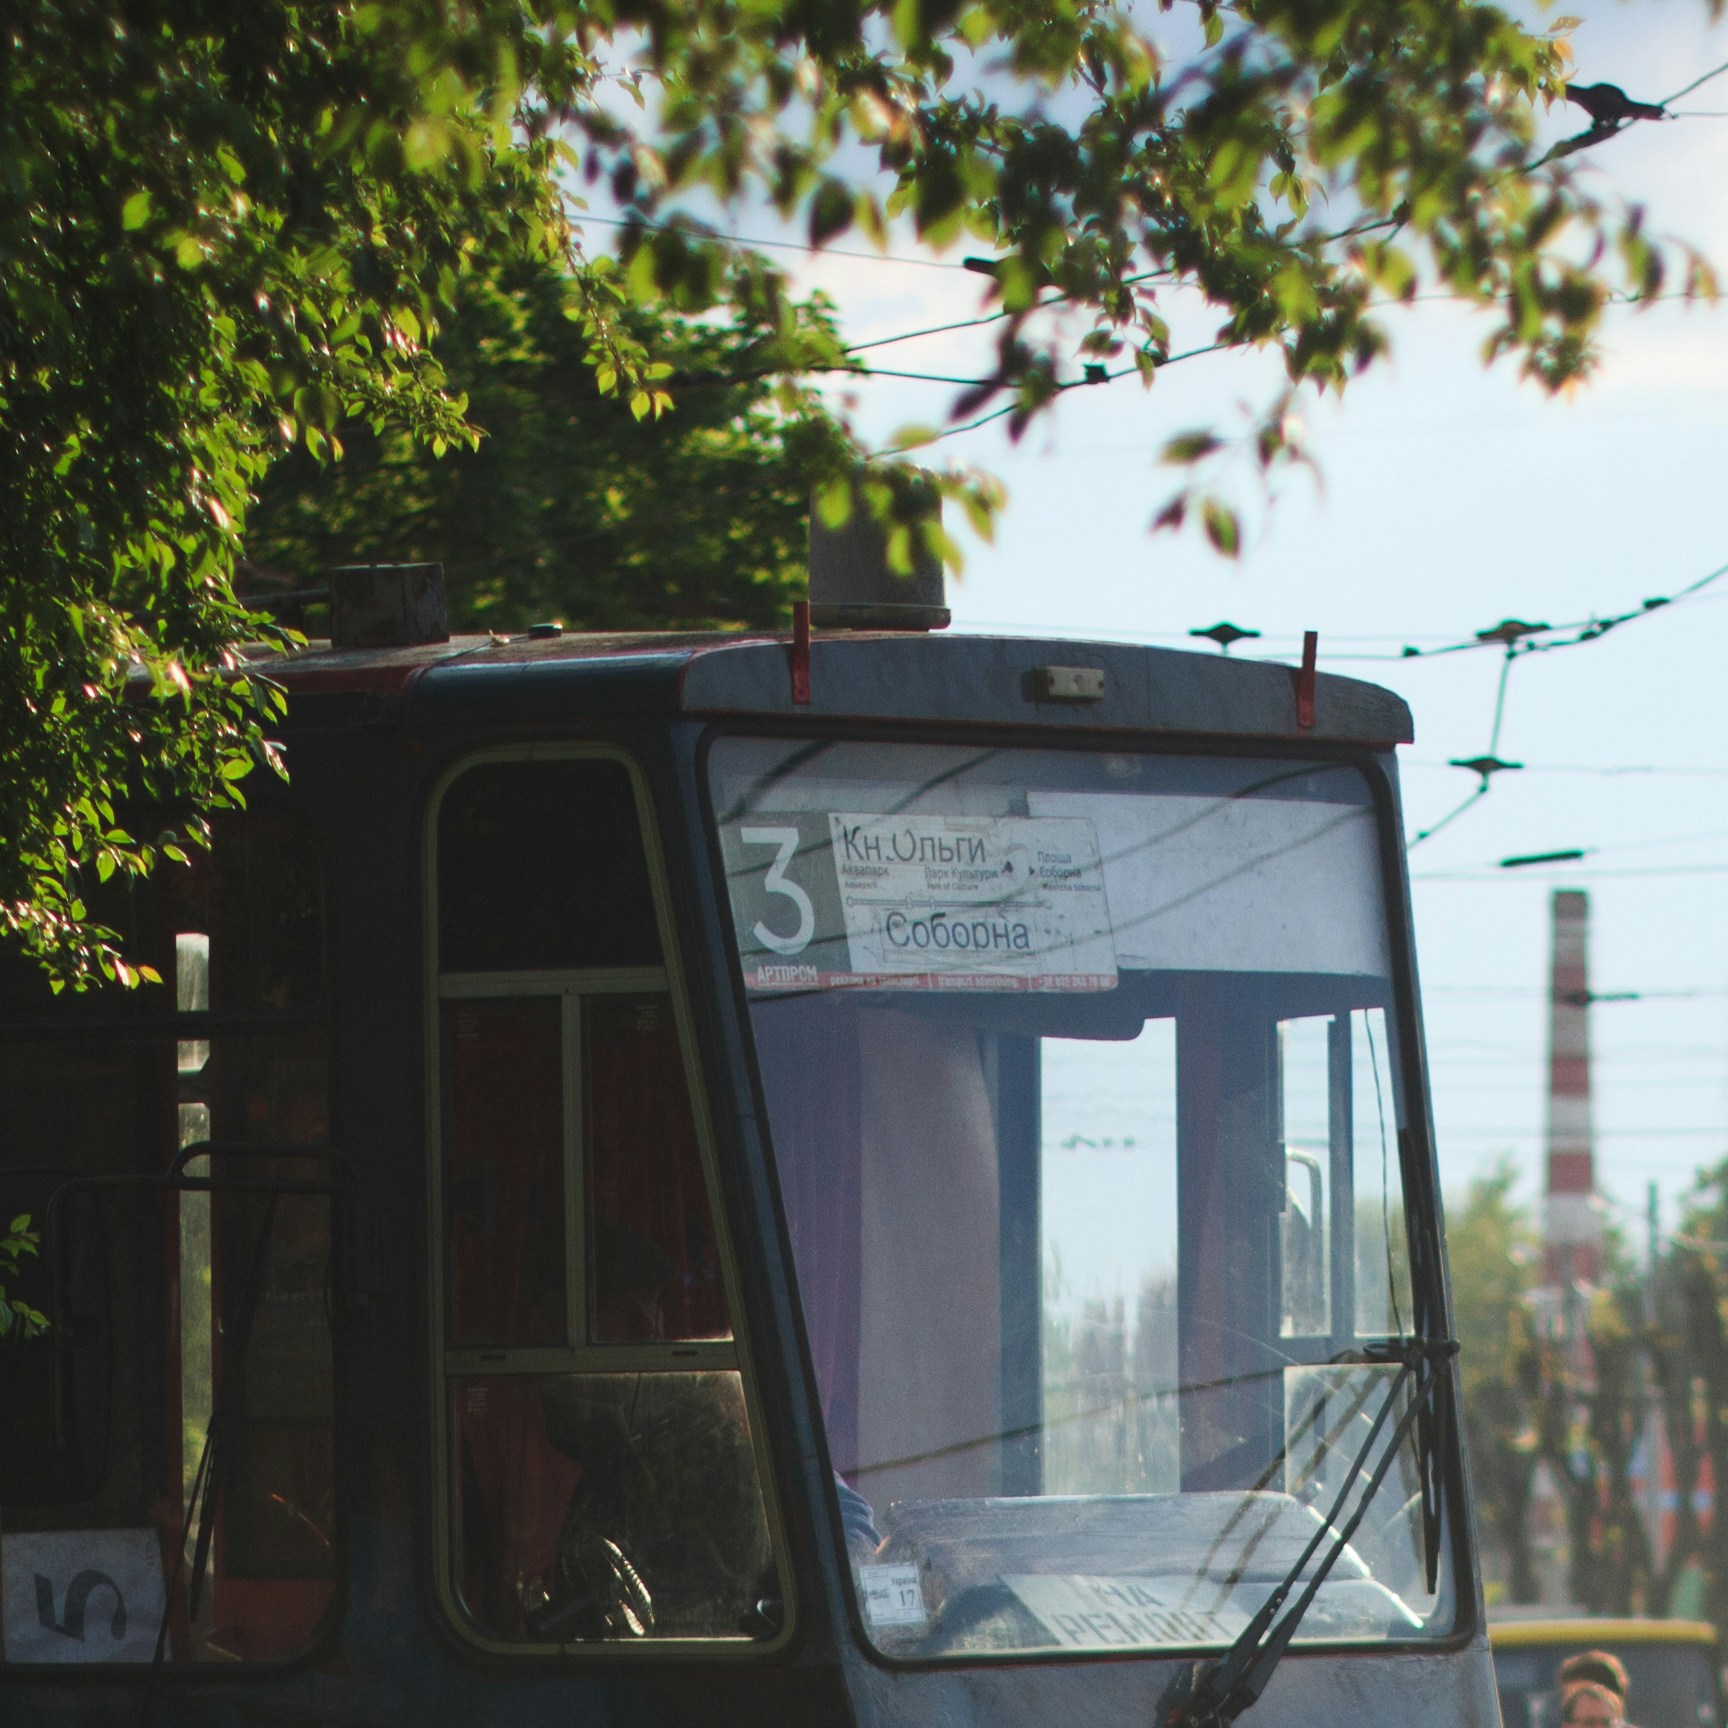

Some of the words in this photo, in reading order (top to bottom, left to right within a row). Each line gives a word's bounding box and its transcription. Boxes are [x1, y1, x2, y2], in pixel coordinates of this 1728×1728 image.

[841, 863, 889, 877] Аквапарк
[741, 827, 815, 955] 3
[885, 911, 1031, 950] Соборна
[757, 964, 817, 983] АРТПРОМ
